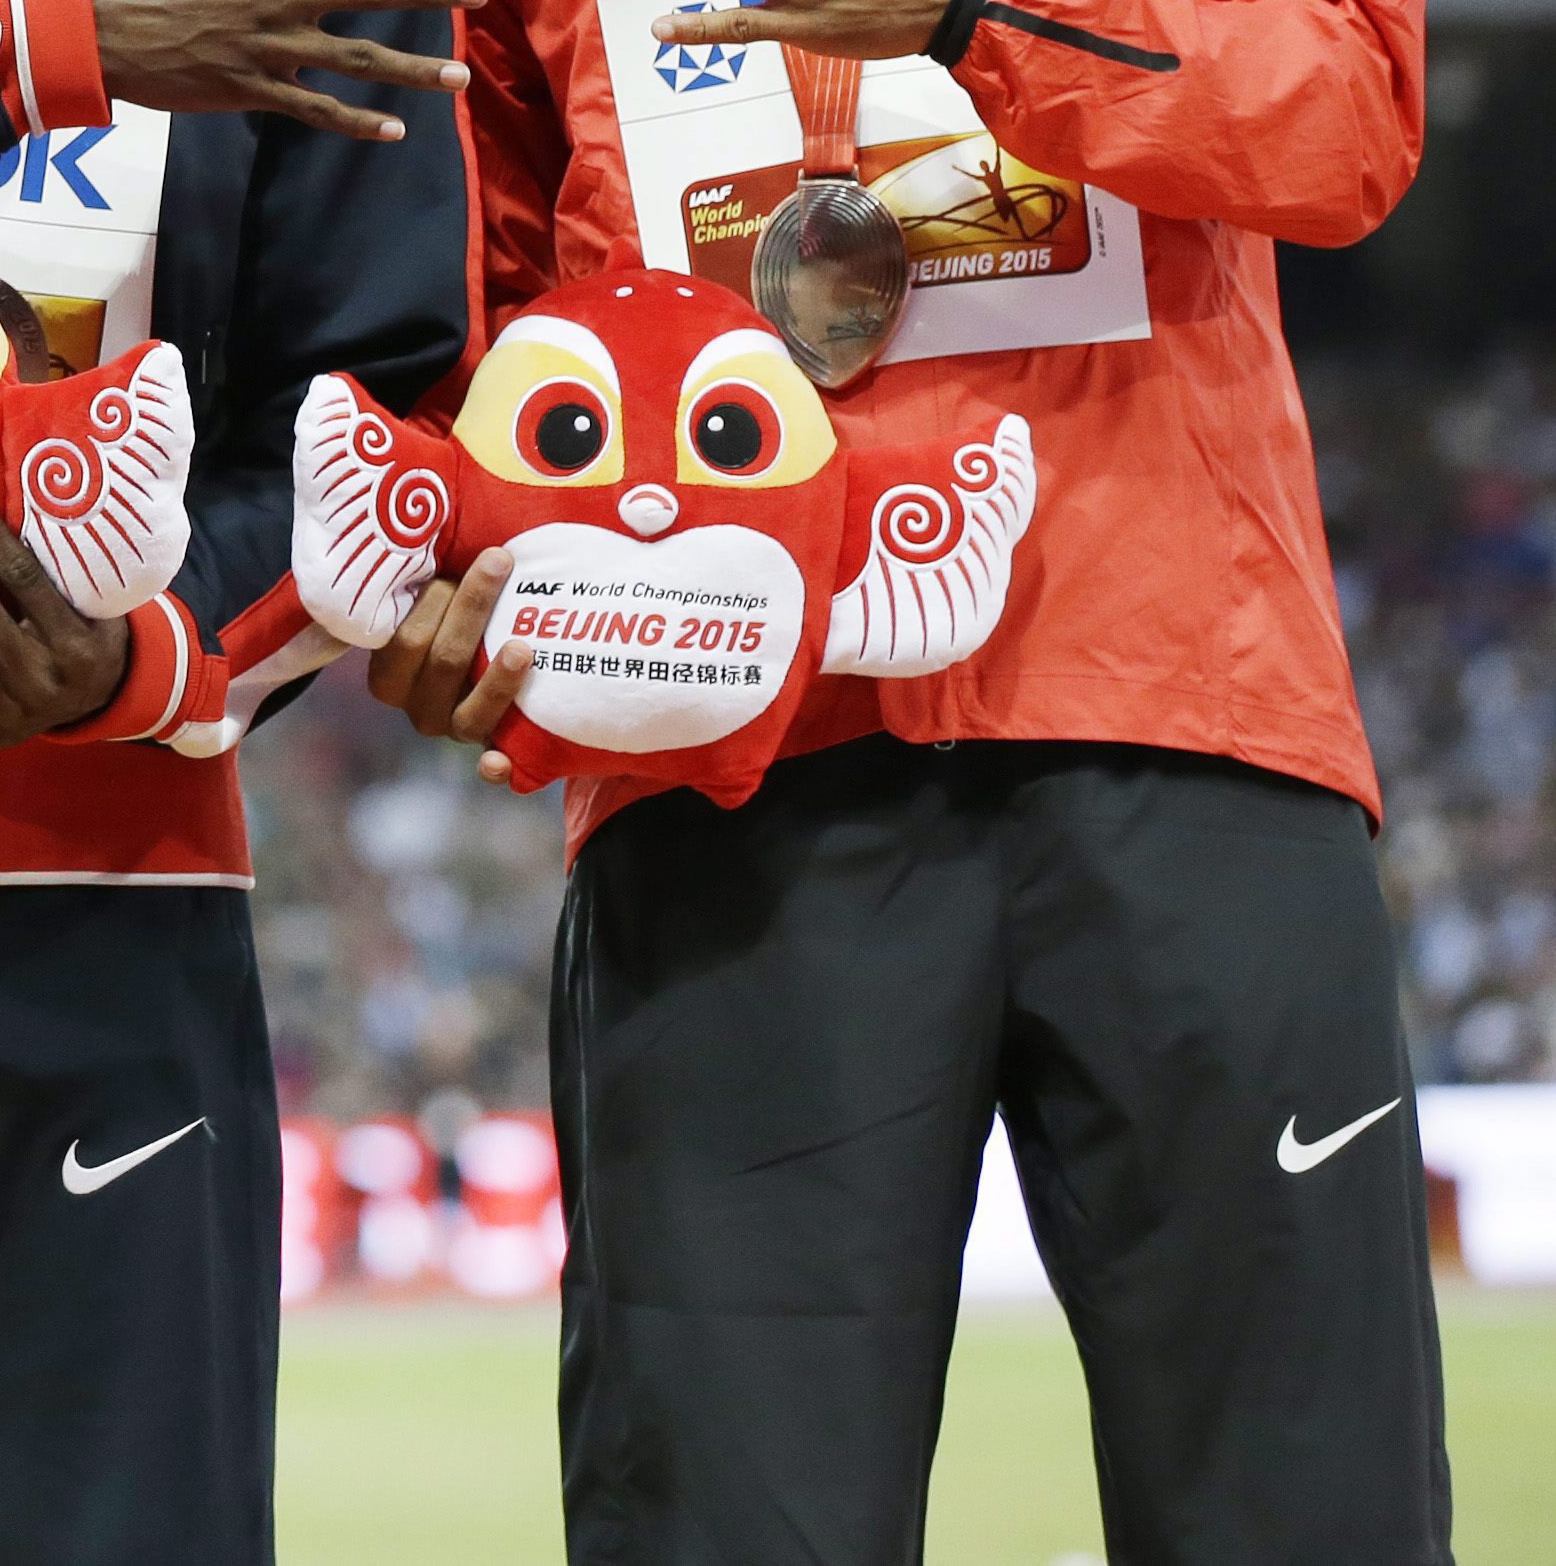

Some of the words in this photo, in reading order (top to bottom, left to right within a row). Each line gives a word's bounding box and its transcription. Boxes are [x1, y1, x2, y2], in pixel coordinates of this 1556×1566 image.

[689, 184, 733, 208] IAAF
[691, 200, 743, 227] World
[694, 213, 770, 244] Champio
[999, 248, 1052, 273] 2015
[516, 581, 565, 596] IAAF
[571, 582, 626, 598] World
[631, 582, 768, 612] Championships
[511, 606, 666, 646] BEIJING
[674, 618, 766, 652] 2015
[529, 649, 762, 685] 际田联世界田径锦标赛
